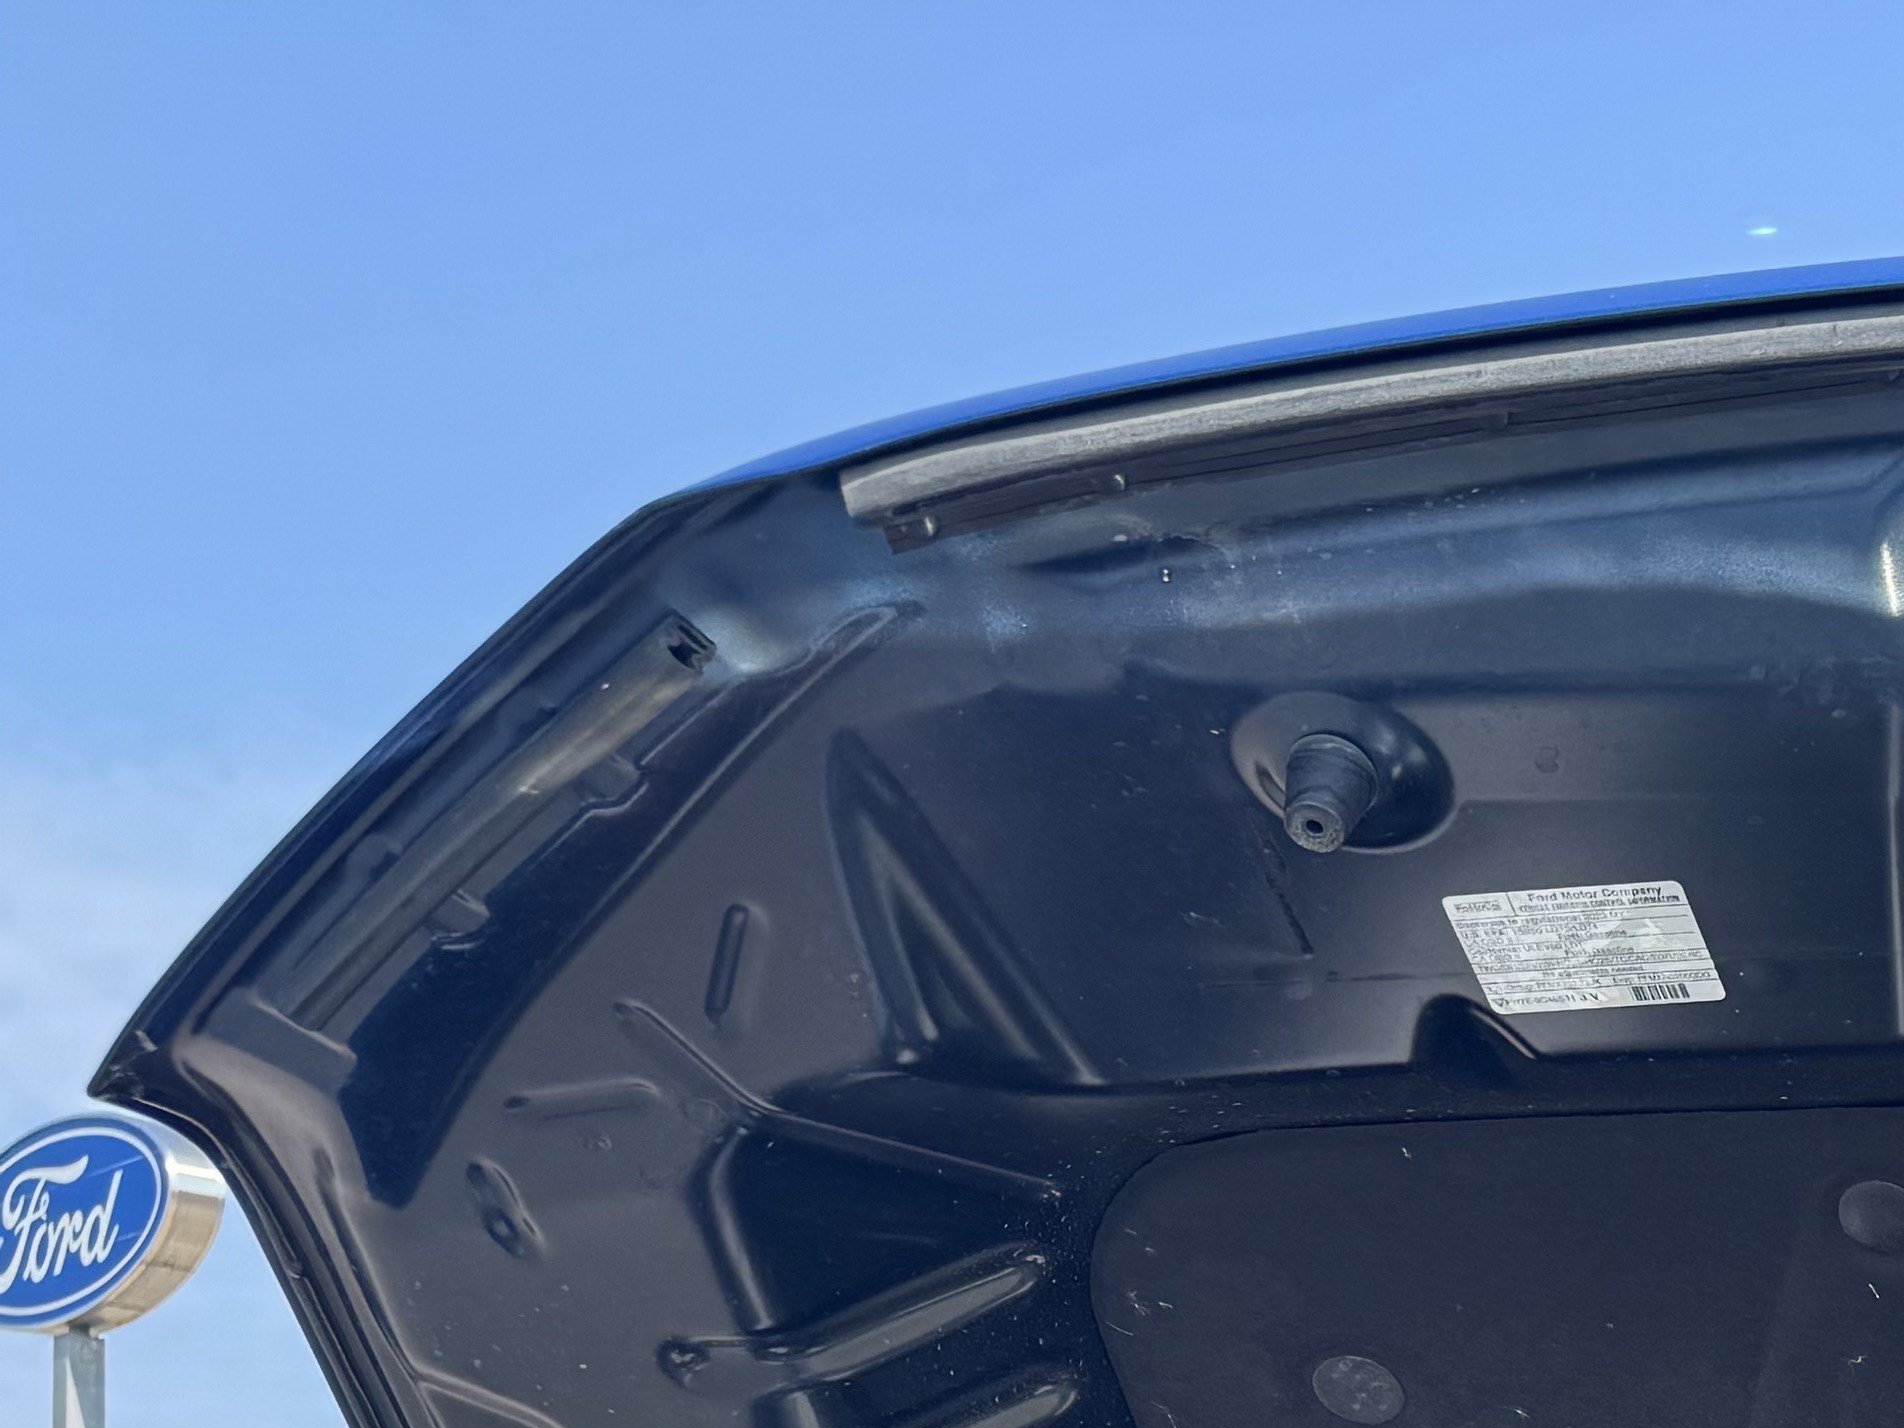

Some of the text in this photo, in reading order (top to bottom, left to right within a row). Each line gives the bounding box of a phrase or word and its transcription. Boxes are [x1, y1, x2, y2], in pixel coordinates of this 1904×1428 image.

[1527, 886, 1662, 903] Ford Motor Company
[0, 1153, 123, 1296] Ford
